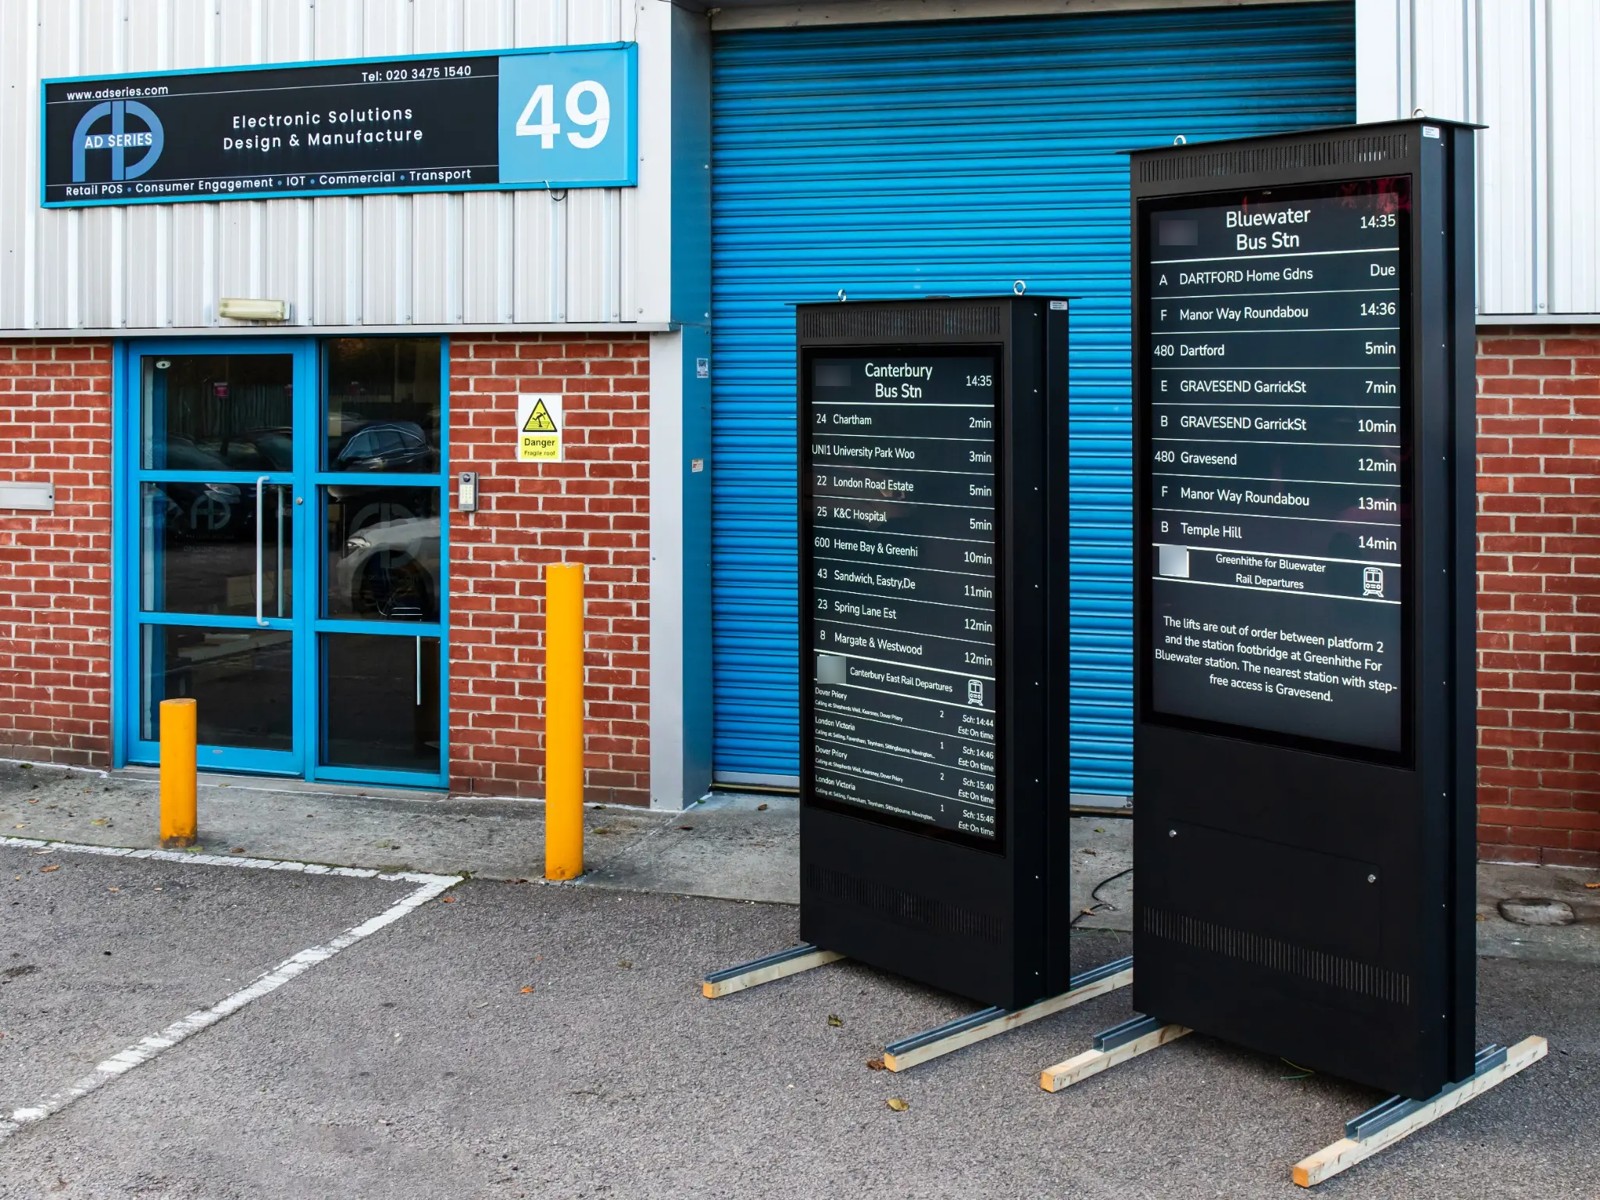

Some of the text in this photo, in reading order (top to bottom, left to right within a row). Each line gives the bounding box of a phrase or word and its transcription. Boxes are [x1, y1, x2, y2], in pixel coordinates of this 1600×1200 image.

[362, 65, 471, 82] Tel: 020 3475 1540
[66, 86, 169, 101] www.adseries.com
[233, 107, 412, 129] Electronic Solutions
[515, 80, 610, 149] 49
[84, 133, 152, 148] AD SERIES
[224, 129, 423, 152] Design & Manufacture
[66, 168, 472, 196] Retail POS Consumer Engagement IOT Commercial Transport
[1226, 208, 1311, 228] Bluewater
[1361, 214, 1396, 229] 14:35
[1237, 231, 1299, 250] Bus Stn
[1159, 264, 1395, 285] A DARTFORD Home Gdns Due
[1161, 302, 1396, 321] F Manor Way Roundabou 14:36
[1154, 342, 1396, 356] 480 Dartford 5min
[865, 362, 933, 380] Canterbury
[966, 375, 992, 386] 14:35
[875, 383, 922, 398] Bus Stn
[1161, 380, 1167, 392] E
[1180, 380, 1251, 392] GRAVESEND
[1365, 381, 1396, 393] 7min
[816, 413, 992, 428] 24 Chartham 2min
[1161, 415, 1168, 427] B
[1180, 415, 1251, 429] GRAVESEND
[1358, 419, 1396, 433] 10min
[524, 438, 555, 448] Danger
[833, 445, 873, 459] University
[875, 447, 893, 458] Park
[894, 448, 915, 459] Woo
[969, 451, 992, 462] 3min
[1154, 451, 1396, 472] 480 Gravesend 12min
[817, 475, 992, 496] 22 London Road Estate 5min
[1162, 486, 1397, 511] F Manor Way Roundabou 13min
[817, 506, 992, 530] 25 K&C Hospital 5min
[1161, 521, 1397, 550] B Temple Hill 14min
[814, 536, 830, 548] 600
[860, 541, 875, 555] Bay
[877, 543, 884, 554] &
[885, 543, 918, 557] Greenhi
[964, 551, 992, 564] 10min
[1216, 553, 1326, 572] Greenhithe for Bluewater
[817, 568, 827, 579] 43
[964, 585, 992, 598] 11min
[1236, 573, 1304, 589] Rail Departures
[818, 598, 992, 632] 23 Spring Lane Est 12min
[1163, 615, 1384, 653] The lifts are out of order between platform 2
[820, 630, 992, 666] 8 Margate & Westwood 12min
[1165, 635, 1383, 671] and the station footbridge at Greenhithe For
[850, 667, 953, 693] Canterbury East Rail Departures
[1155, 648, 1397, 694] Bluewater station. The nearest station with step-
[831, 690, 847, 701] Priory
[1209, 674, 1333, 702] free access is Gravesend.
[815, 716, 855, 731] London Victoria
[976, 717, 994, 727] 14:44
[831, 749, 848, 760] Priory
[976, 749, 994, 759] 14:46
[816, 775, 856, 791] London Victoria
[976, 781, 994, 791] 15:40
[976, 813, 994, 824] 15:46
